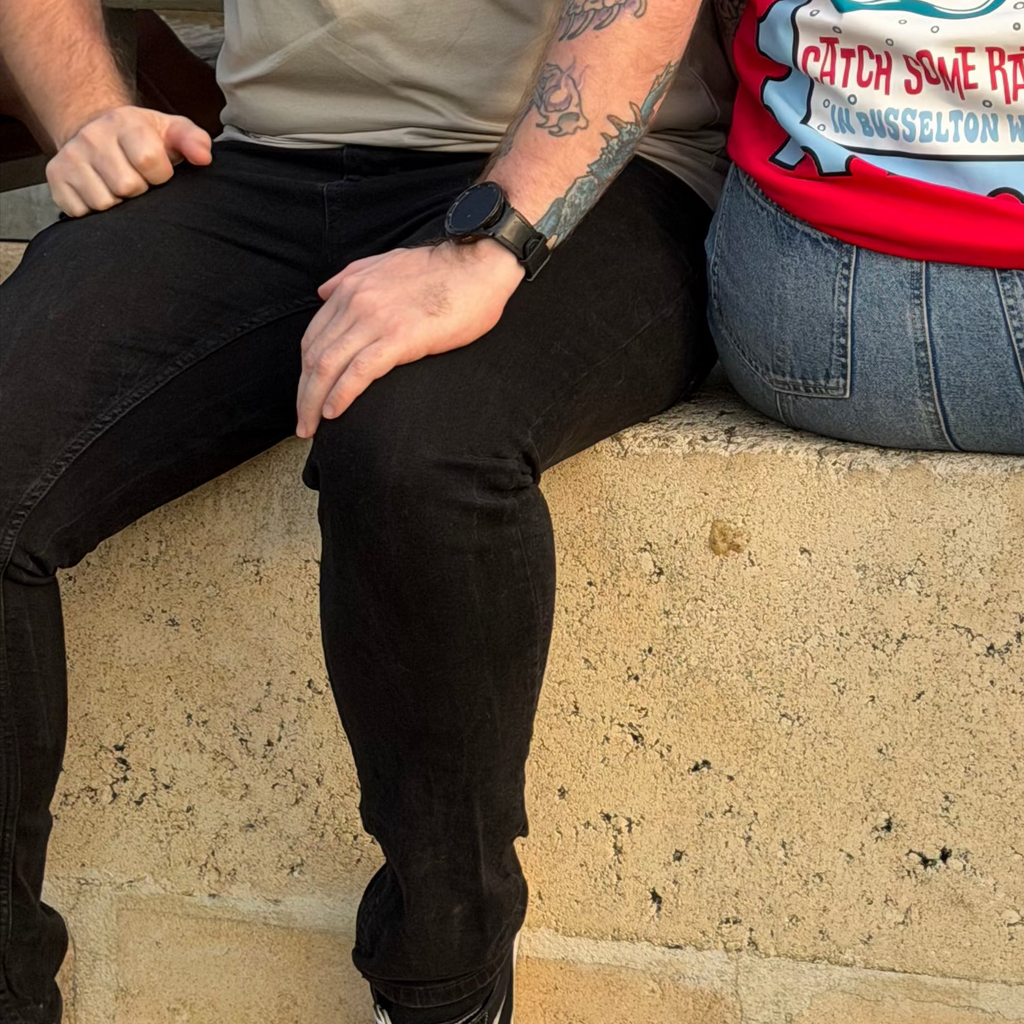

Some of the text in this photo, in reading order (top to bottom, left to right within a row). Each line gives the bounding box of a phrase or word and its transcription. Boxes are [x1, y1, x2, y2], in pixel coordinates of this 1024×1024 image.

[801, 36, 893, 96] CATCH
[902, 46, 979, 101] SOME
[830, 104, 856, 134] IN
[856, 107, 999, 144] BUSSELTON
